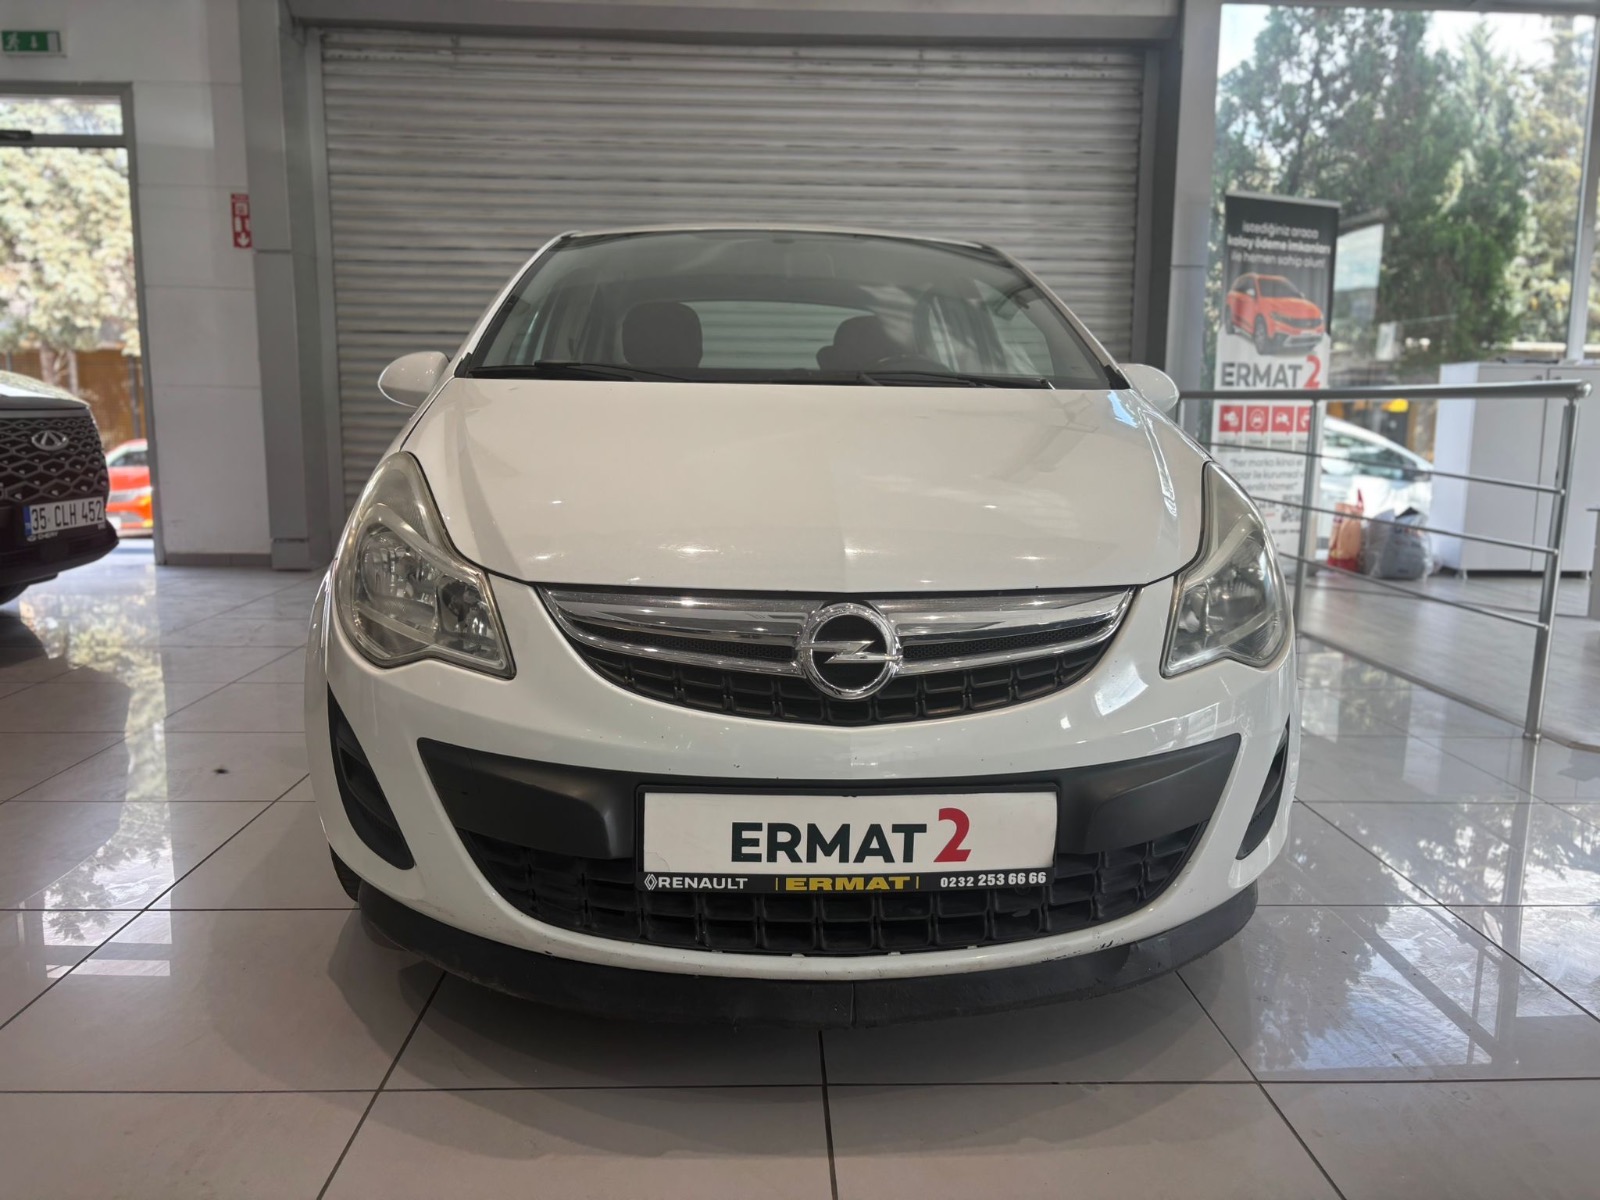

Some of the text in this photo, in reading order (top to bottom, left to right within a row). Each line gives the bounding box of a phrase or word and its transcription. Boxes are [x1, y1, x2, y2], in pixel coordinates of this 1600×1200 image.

[1227, 234, 1254, 250] kolay
[1255, 236, 1286, 251] ödeme
[1243, 251, 1276, 265] hemen
[1278, 255, 1302, 268] sahip
[1221, 363, 1302, 387] ERMAT
[31, 500, 103, 530] 35 CLH 452
[731, 807, 972, 863] ERMAT 2
[658, 871, 1047, 891] RENAULT ERMAT 0232 253 66 66
